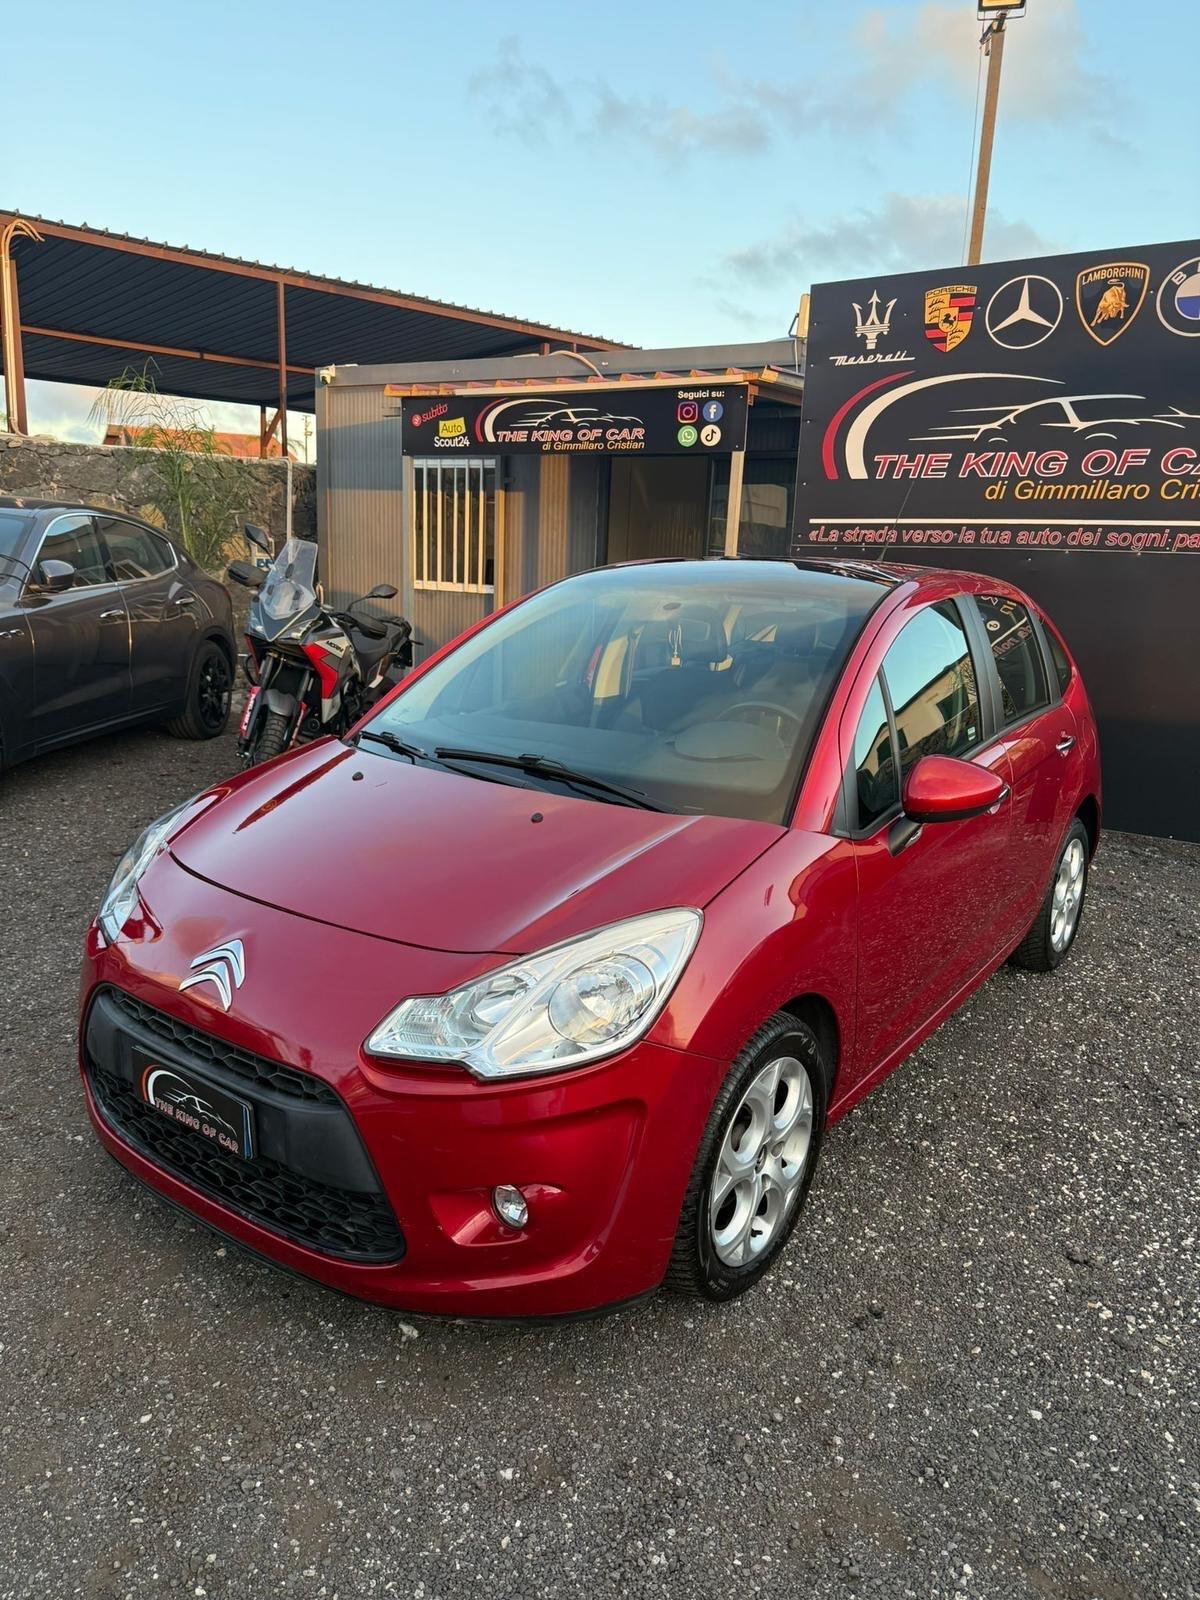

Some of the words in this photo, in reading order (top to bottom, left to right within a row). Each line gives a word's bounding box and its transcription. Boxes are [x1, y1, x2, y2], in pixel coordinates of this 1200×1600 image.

[1082, 267, 1144, 285] LAMBORGHINI
[926, 285, 976, 298] PORSCHE
[829, 350, 916, 367] Maserati
[677, 390, 709, 400] Seguici
[711, 390, 725, 398] su:
[421, 402, 448, 423] subito
[441, 423, 463, 433] Auto
[496, 430, 528, 442] THE
[531, 429, 573, 442] KING
[577, 428, 603, 441] OF
[606, 427, 646, 440] CAR
[434, 436, 470, 448] Scout24
[542, 441, 551, 451] di
[553, 441, 604, 451] Gimmillaro
[607, 440, 645, 450] Cristian
[874, 453, 952, 479] THE
[958, 450, 1069, 478] KING
[1081, 448, 1151, 477] OF
[984, 480, 1008, 500] di
[1014, 479, 1150, 500] Gimmillaro
[842, 526, 898, 543] strada
[902, 528, 954, 544] verso
[958, 526, 975, 544] la
[979, 527, 1012, 544] tua
[1016, 528, 1062, 545] auto
[1066, 527, 1103, 546] dei
[1105, 529, 1170, 551] sogni
[154, 1096, 174, 1116] THE
[176, 1108, 200, 1130] KING
[202, 1123, 217, 1138] OF
[218, 1132, 239, 1153] CAR
